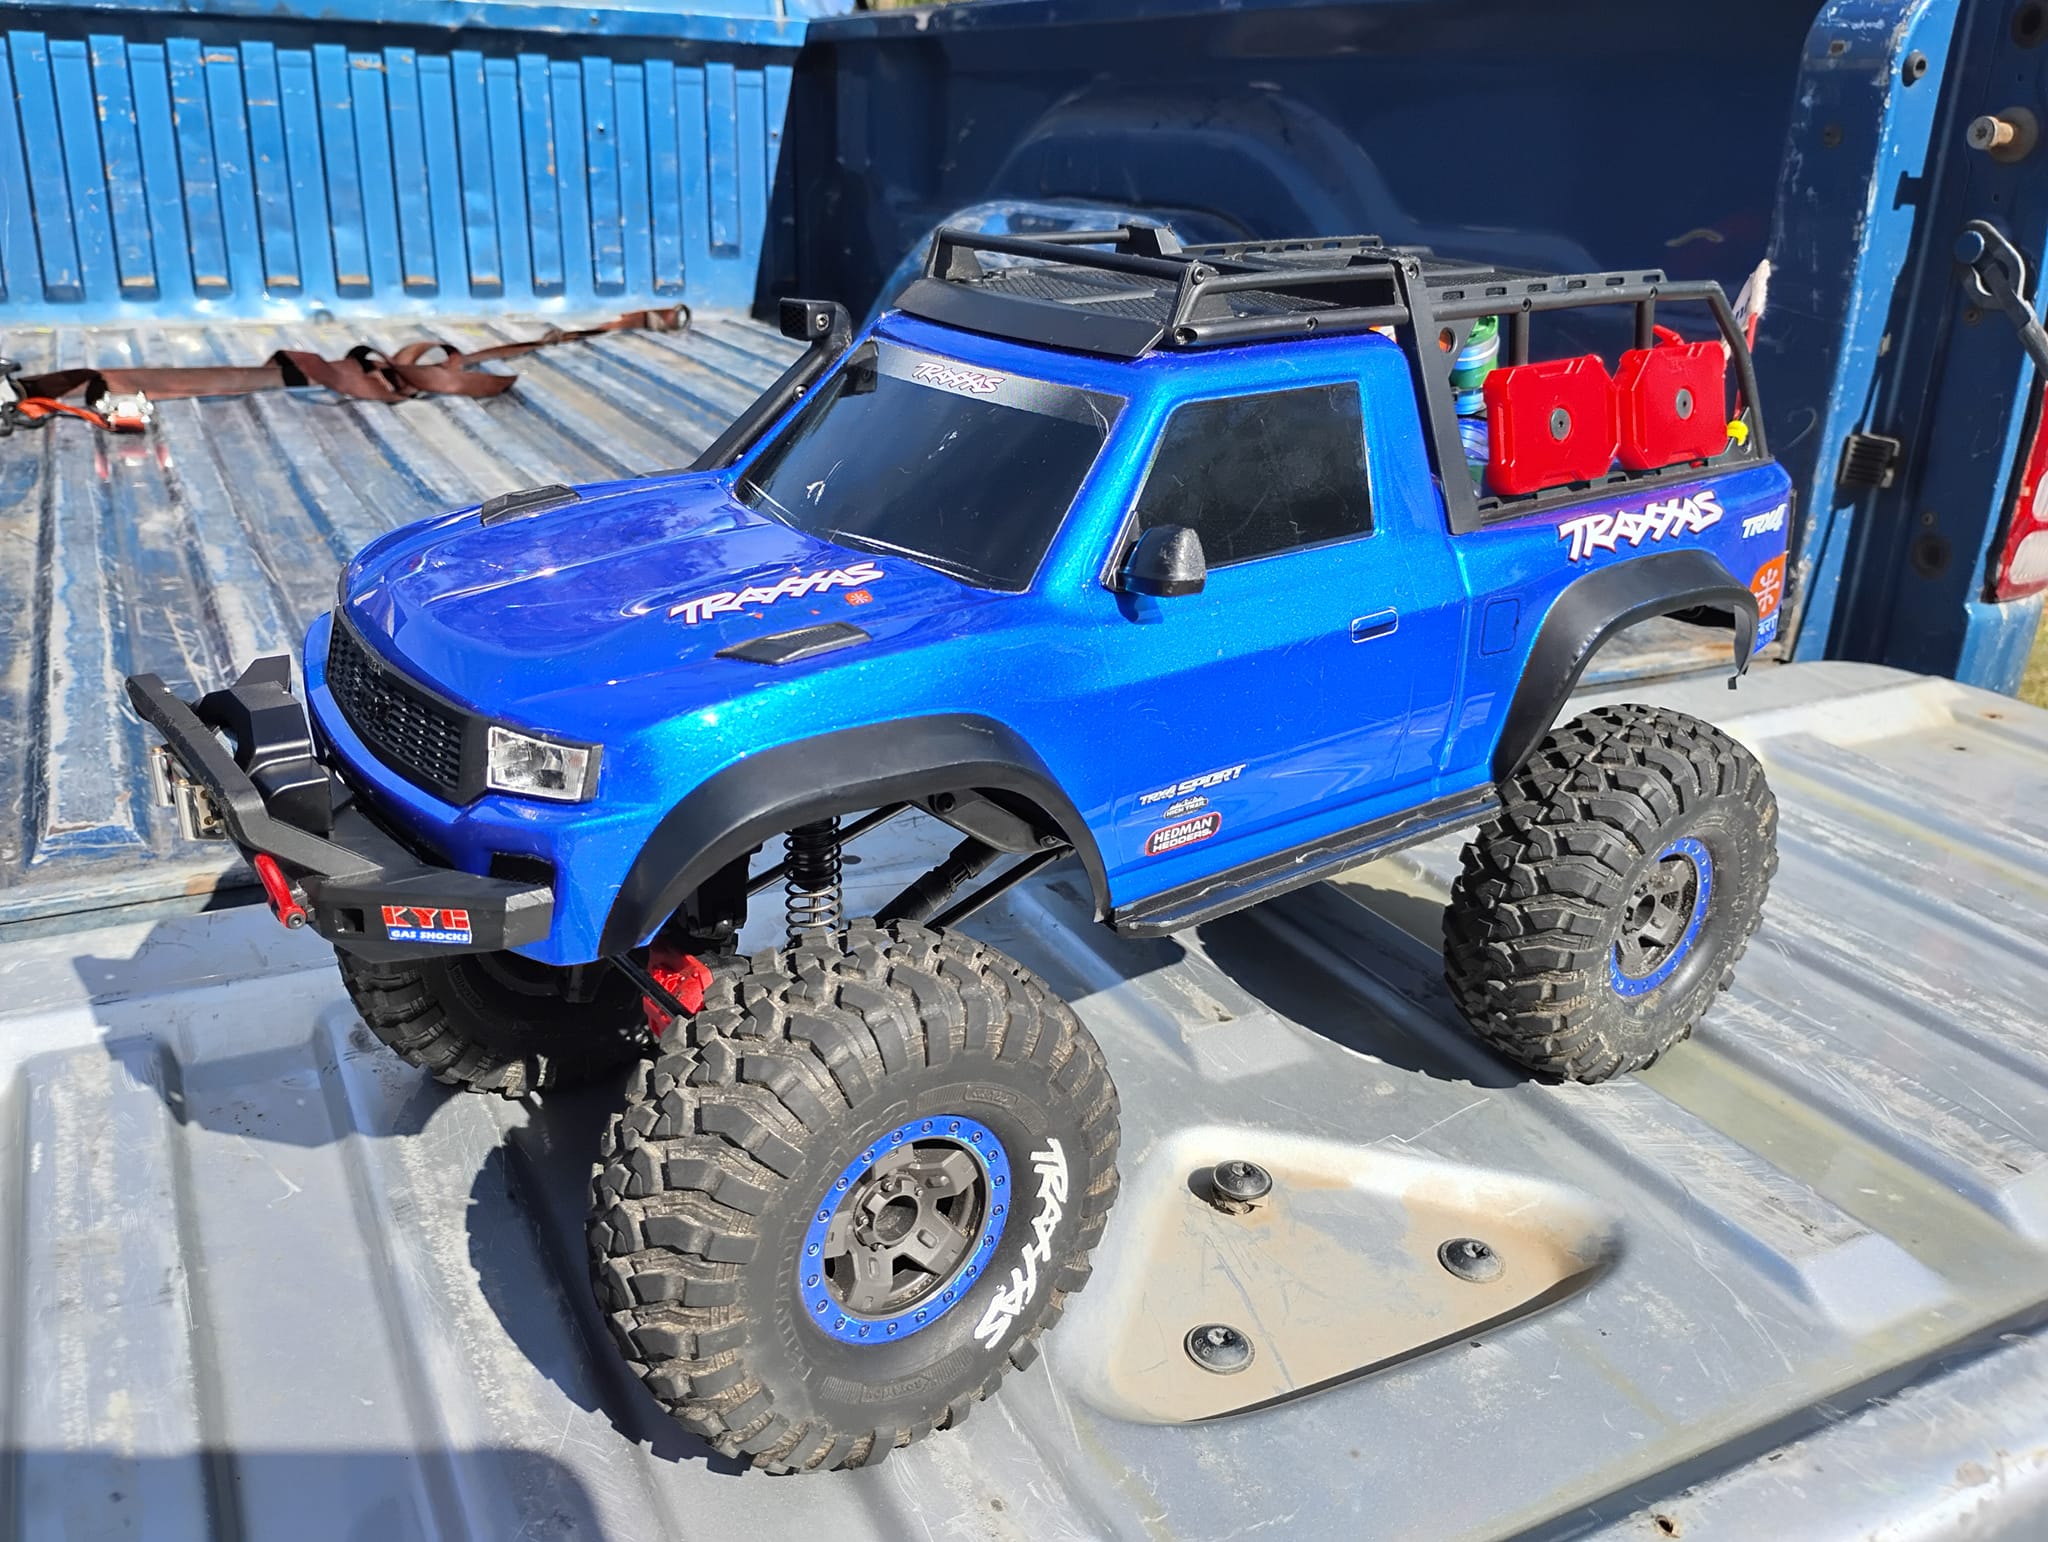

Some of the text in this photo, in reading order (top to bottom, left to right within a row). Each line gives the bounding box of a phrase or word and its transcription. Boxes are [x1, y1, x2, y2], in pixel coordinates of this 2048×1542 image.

[912, 361, 1006, 394] TRAXXAS
[1558, 489, 1724, 564] TRAXXAS
[669, 562, 885, 625] TRAXXAS
[1177, 763, 1247, 796] SPORT
[1153, 816, 1213, 845] HEDMAN
[391, 930, 469, 942] GAS SHOCKS
[974, 1136, 1069, 1349] TRAXXAS
